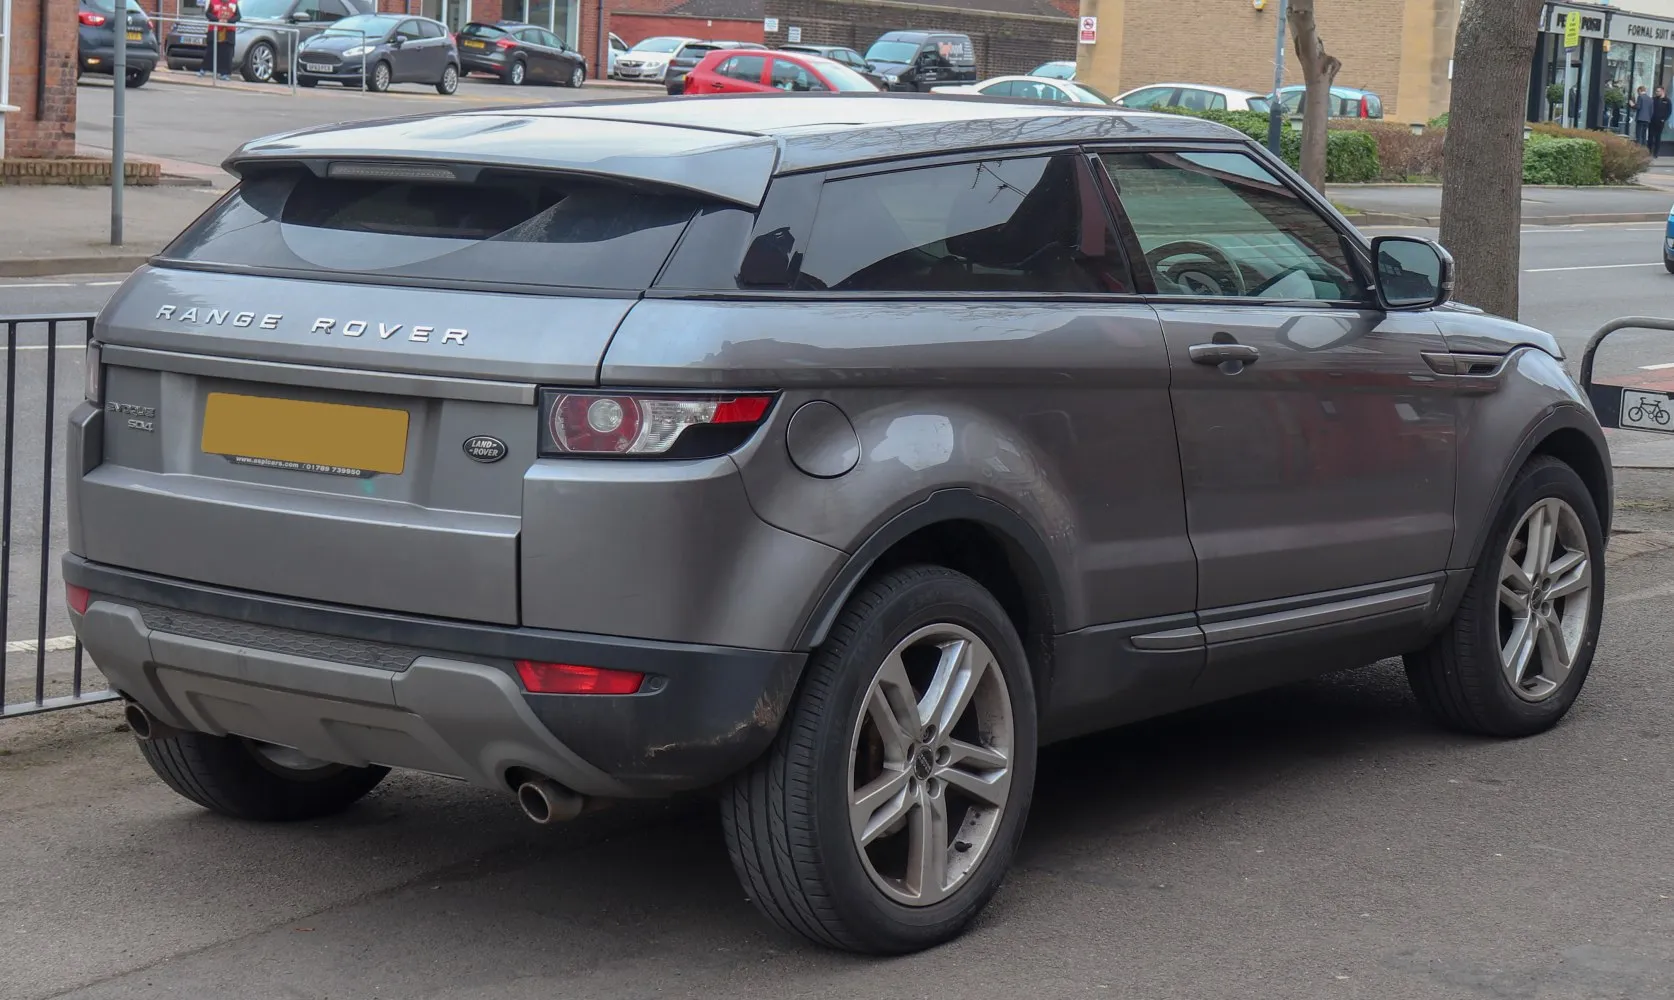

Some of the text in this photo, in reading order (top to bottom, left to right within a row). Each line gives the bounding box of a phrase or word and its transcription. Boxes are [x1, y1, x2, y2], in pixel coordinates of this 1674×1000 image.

[1627, 24, 1653, 39] FORMAL
[1655, 28, 1670, 40] SUIT
[156, 304, 469, 346] RANGE ROVER
[128, 419, 153, 431] SD4
[306, 464, 330, 473] 01789
